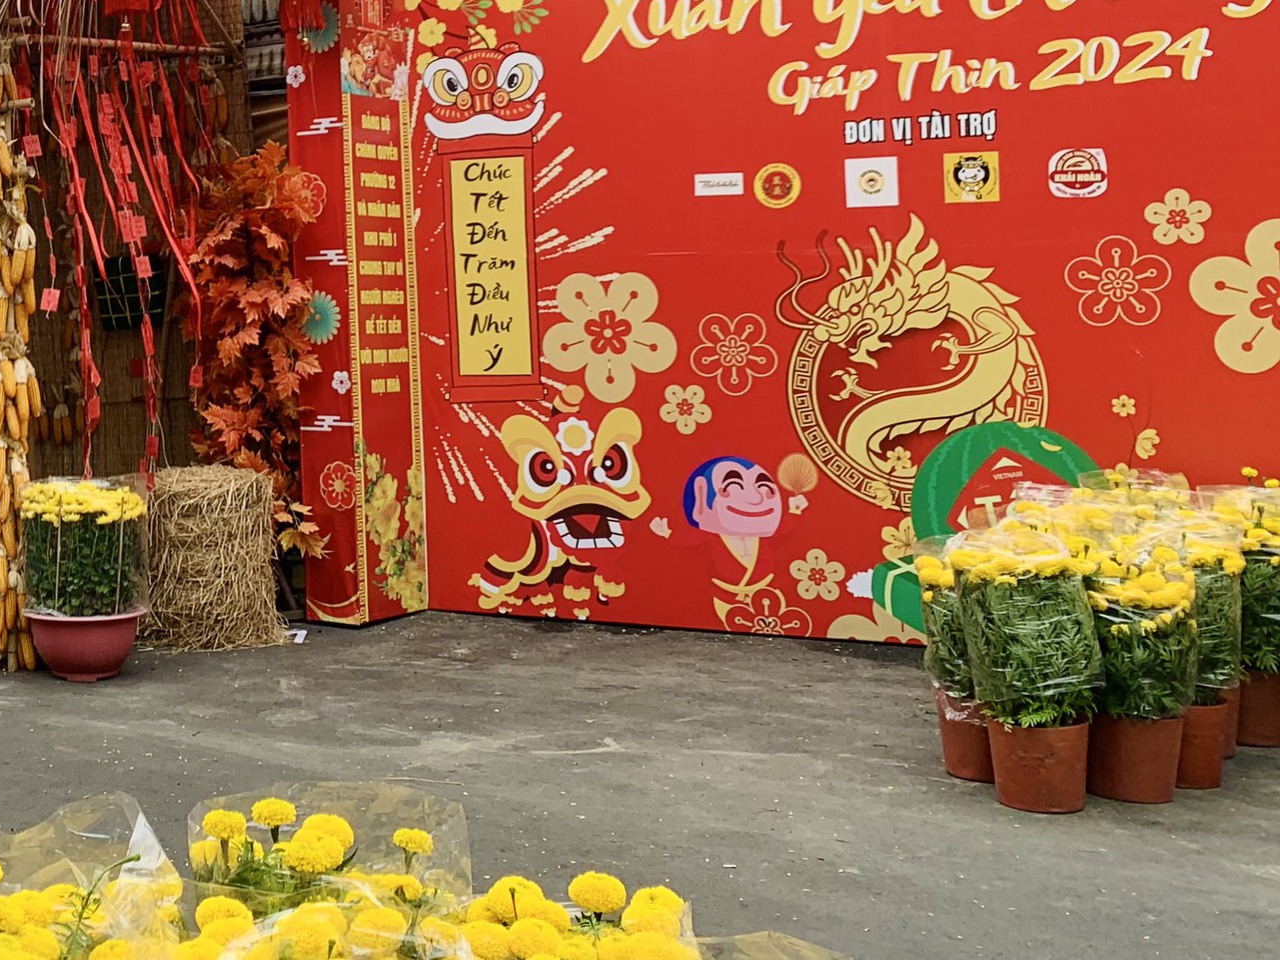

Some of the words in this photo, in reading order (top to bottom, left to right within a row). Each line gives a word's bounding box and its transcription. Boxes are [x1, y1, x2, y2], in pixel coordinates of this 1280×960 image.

[767, 60, 878, 116] Giáp
[886, 49, 1021, 101] Thìn
[1029, 27, 1213, 90] 2024
[844, 118, 885, 144] ĐƠN
[891, 117, 912, 144] VỊ
[918, 110, 951, 138] TÀI
[957, 109, 996, 140] TRỢ
[464, 162, 512, 182] Chúc
[469, 191, 509, 214] Tết
[466, 221, 508, 245] Đến
[459, 253, 515, 274] Trăm
[466, 282, 509, 305] Điều
[470, 313, 513, 336] Như
[992, 471, 1024, 480] VIETNAM
